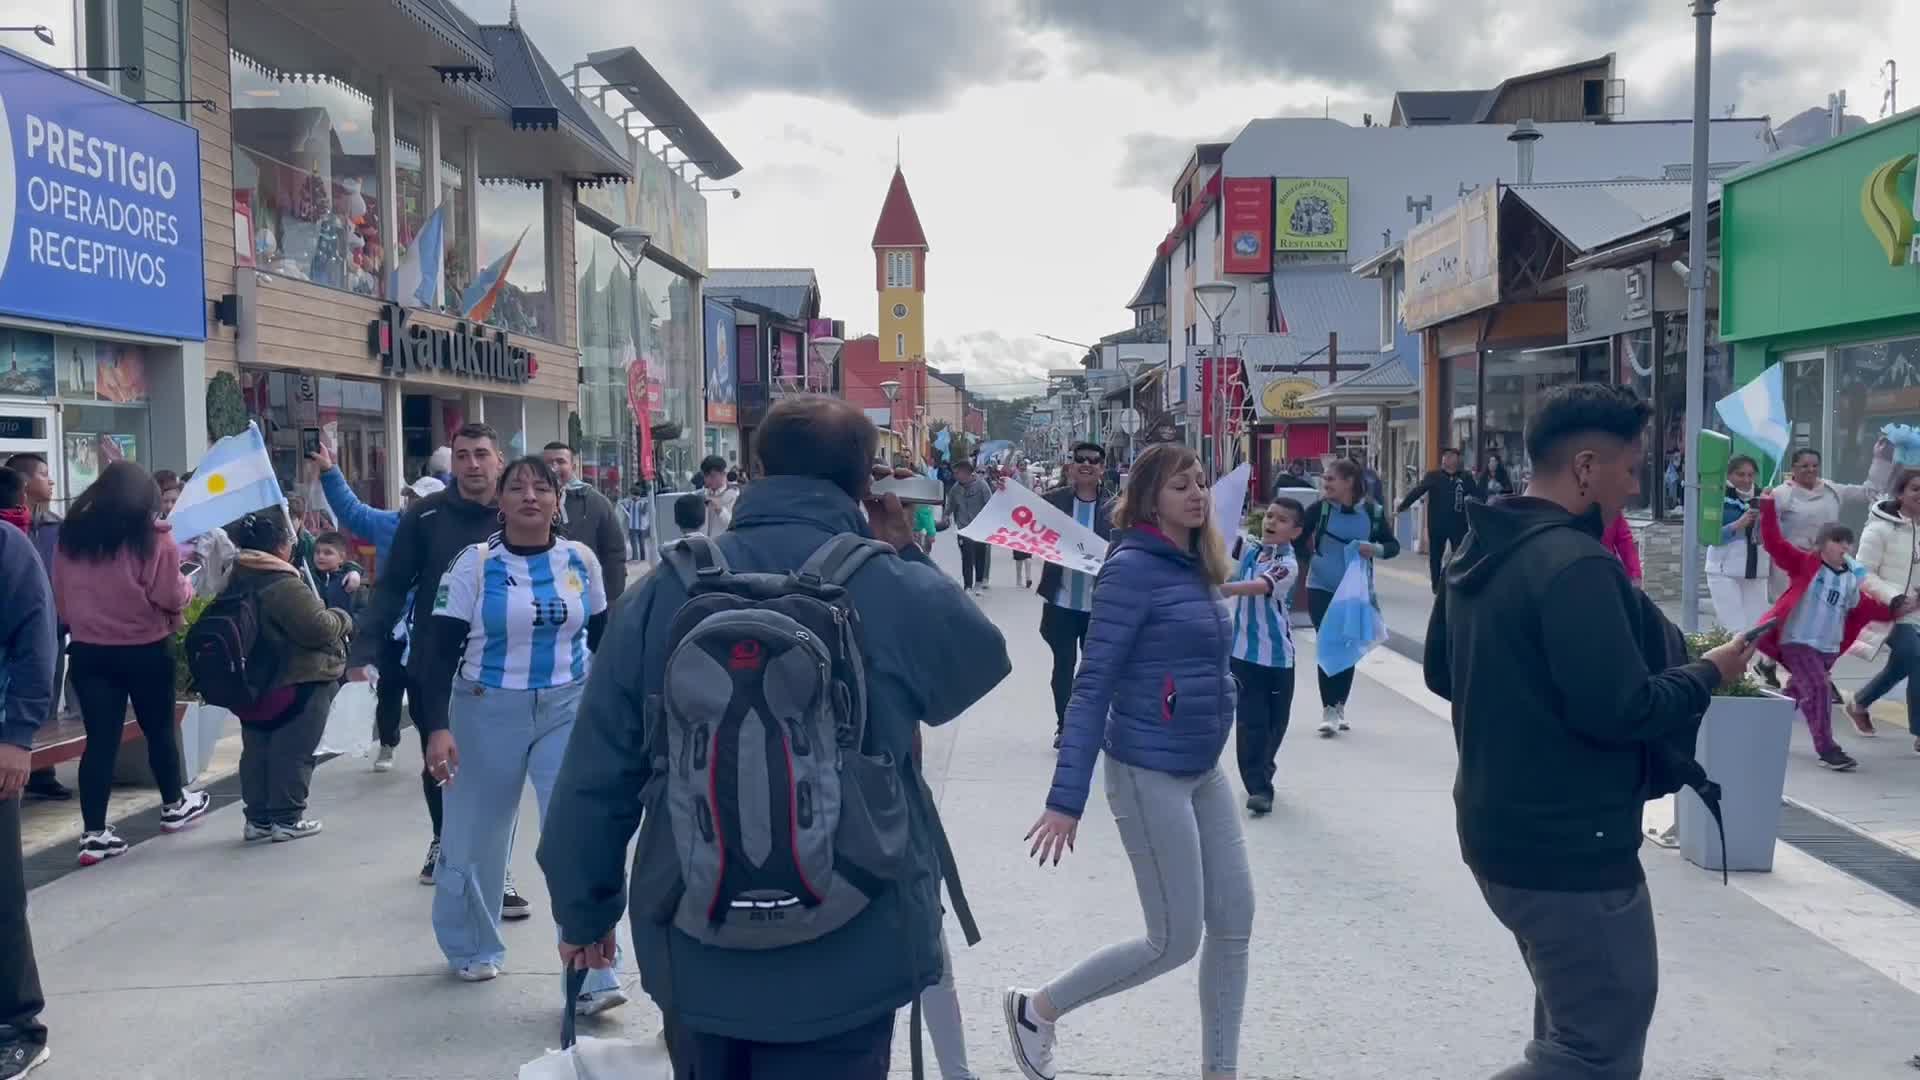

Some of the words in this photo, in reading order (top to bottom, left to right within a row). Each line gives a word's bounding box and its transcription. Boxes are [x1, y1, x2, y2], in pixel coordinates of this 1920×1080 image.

[26, 113, 177, 200] PRESTIGIO
[28, 176, 178, 246] OPERADORES
[29, 227, 167, 287] RECEPTIVOS
[1280, 239, 1345, 249] RESTAURANT
[384, 303, 528, 384] Karukinka
[1011, 505, 1062, 545] QUE
[531, 598, 568, 627] 10
[1826, 589, 1840, 606] 10
